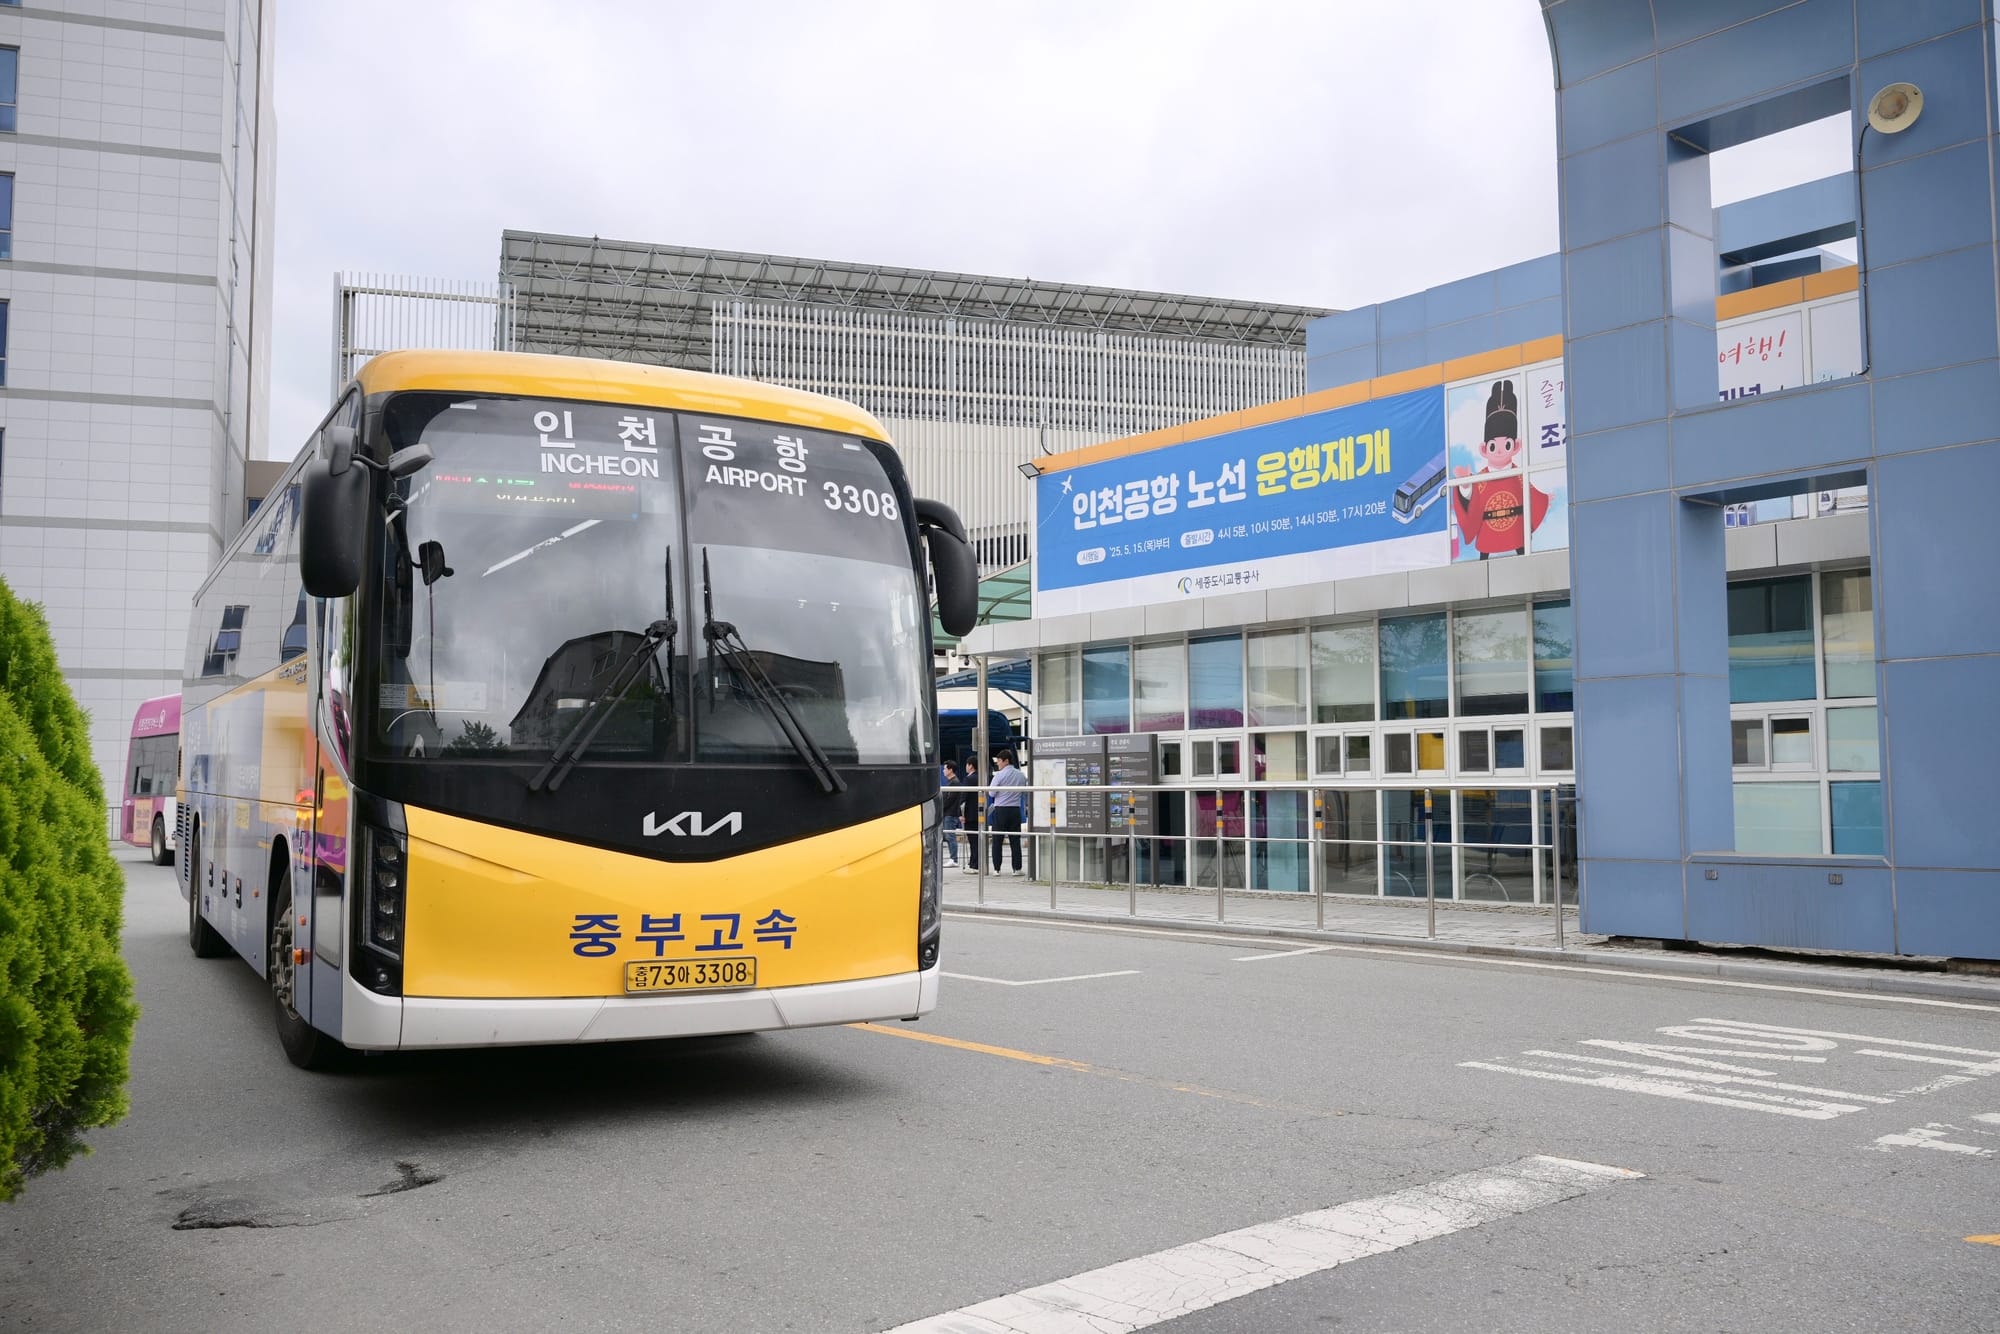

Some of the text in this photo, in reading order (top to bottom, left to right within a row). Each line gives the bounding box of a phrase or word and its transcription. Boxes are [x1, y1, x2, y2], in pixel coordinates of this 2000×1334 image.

[1719, 329, 1786, 365] 여행!
[541, 453, 807, 497] INCHEON AIRPORT
[1073, 428, 1390, 530] 인천공항 노선 운행재개
[823, 481, 898, 521] 3308
[1217, 527, 1231, 540] 4시
[1233, 525, 1248, 538] 5분,
[1251, 521, 1269, 535] 10시
[1271, 517, 1293, 531] 50분,
[1295, 514, 1315, 528] 14시
[1317, 509, 1339, 524] 50분,
[1342, 505, 1362, 519] 17시
[1365, 501, 1387, 516] 20분
[1195, 570, 1260, 589] 세종도시교통공사
[642, 811, 742, 837] KIA
[569, 909, 797, 957] 중부고속
[695, 962, 747, 984] 3308
